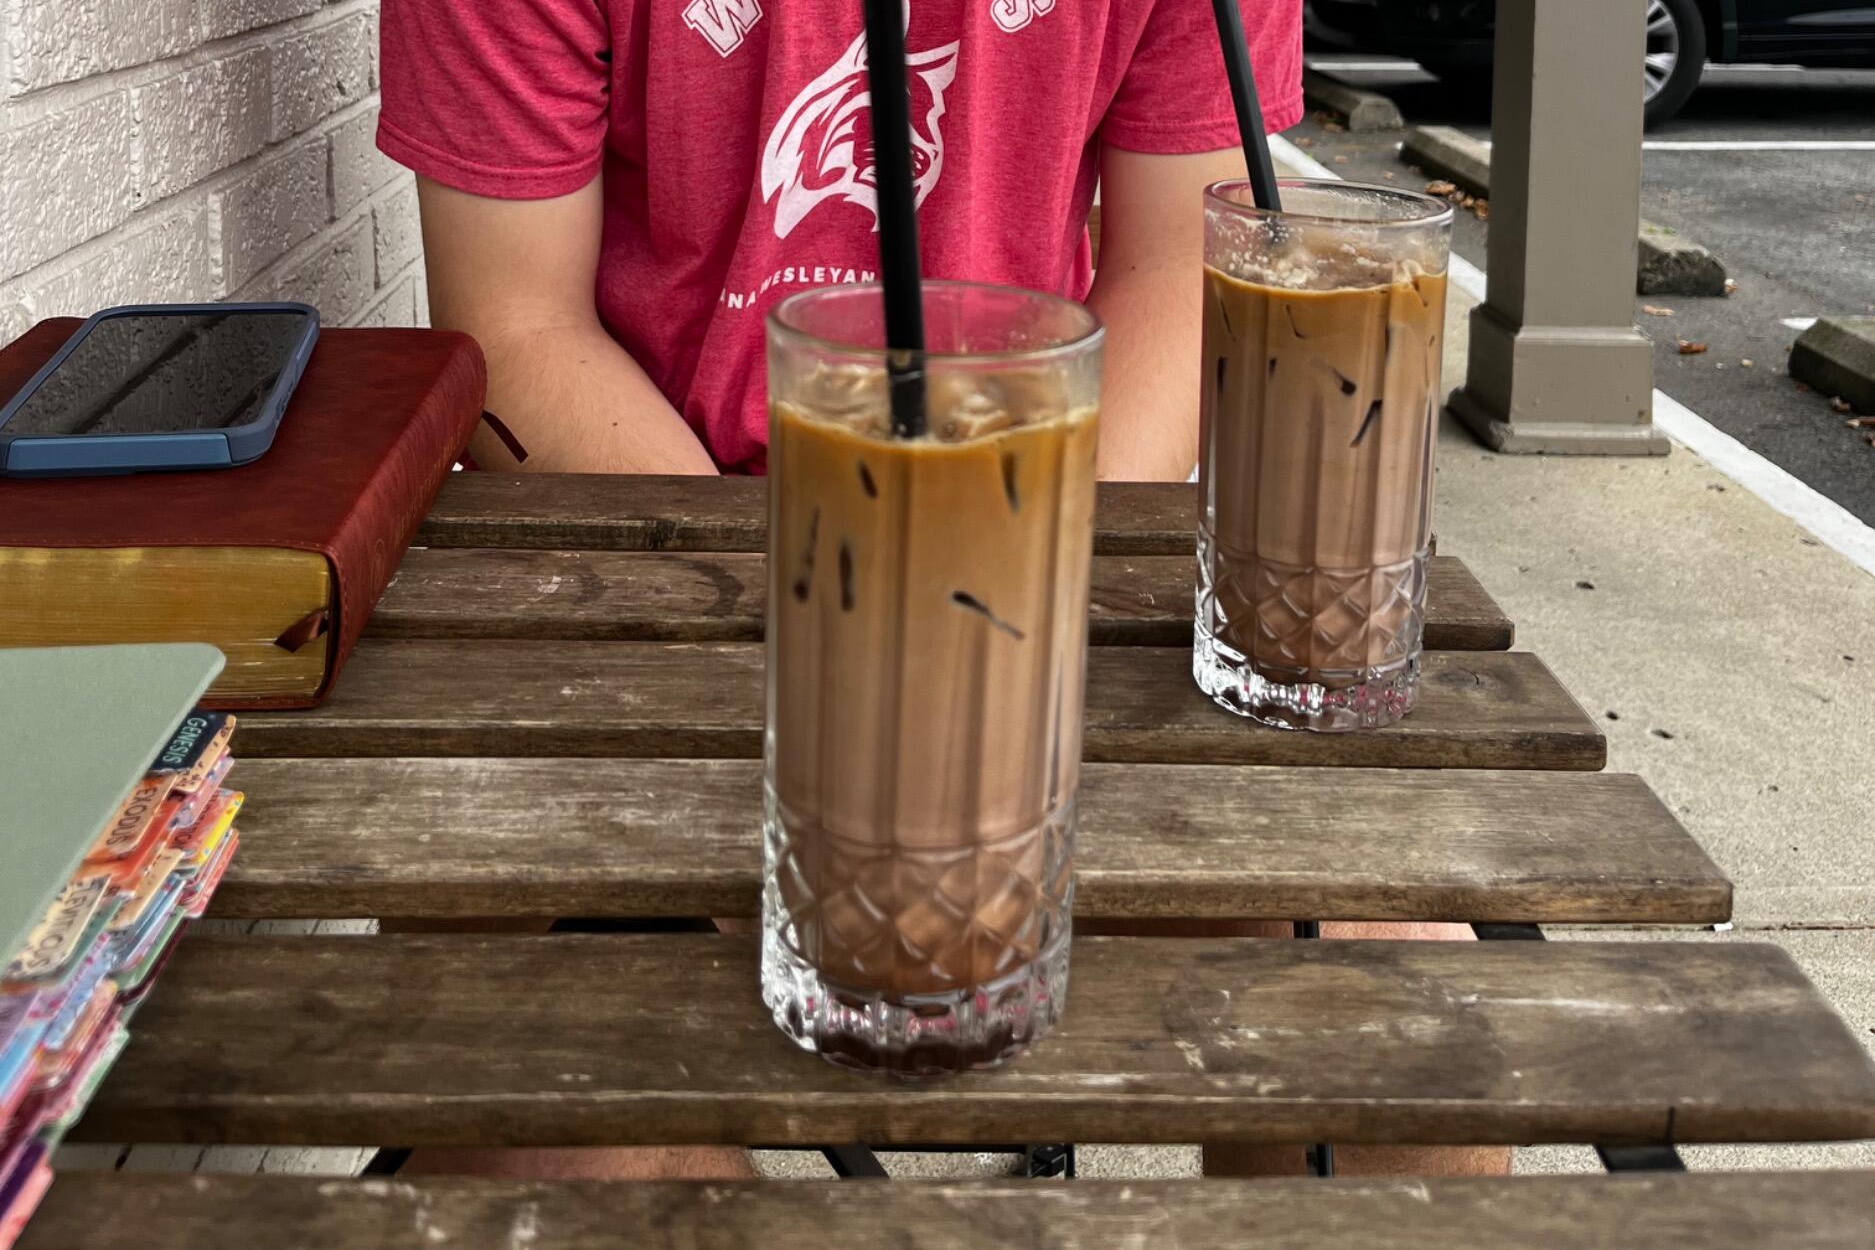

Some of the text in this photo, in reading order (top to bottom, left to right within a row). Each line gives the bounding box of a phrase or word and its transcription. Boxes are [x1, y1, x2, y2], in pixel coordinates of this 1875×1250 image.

[760, 267, 876, 294] WESLEYAN
[162, 717, 208, 764] GENESIS
[106, 786, 158, 846] EXODUS
